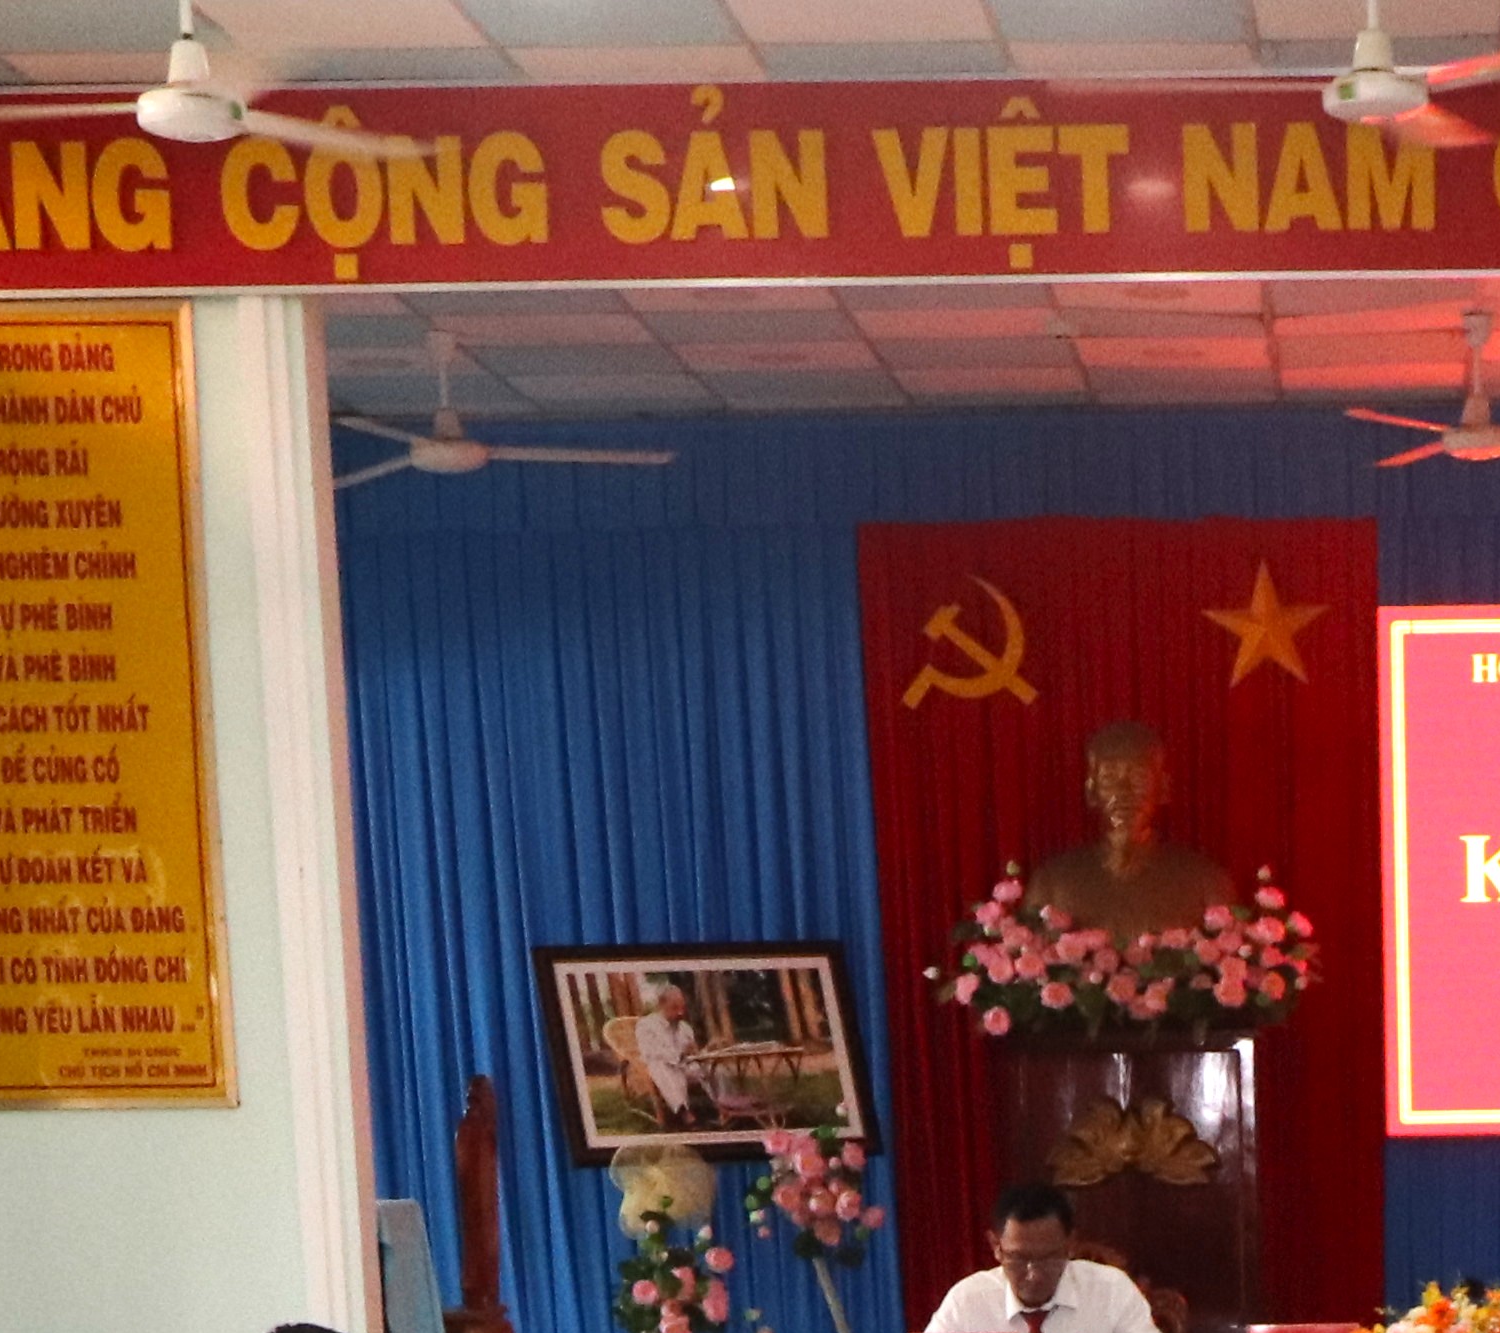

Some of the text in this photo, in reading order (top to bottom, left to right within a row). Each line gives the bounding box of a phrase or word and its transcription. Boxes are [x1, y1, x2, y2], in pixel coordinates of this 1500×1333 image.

[220, 105, 550, 281] CỘNG
[600, 85, 829, 244] SẢN
[872, 98, 1128, 270] VIỆT
[1182, 112, 1435, 238] NAM
[59, 332, 114, 372] ĐẢNG
